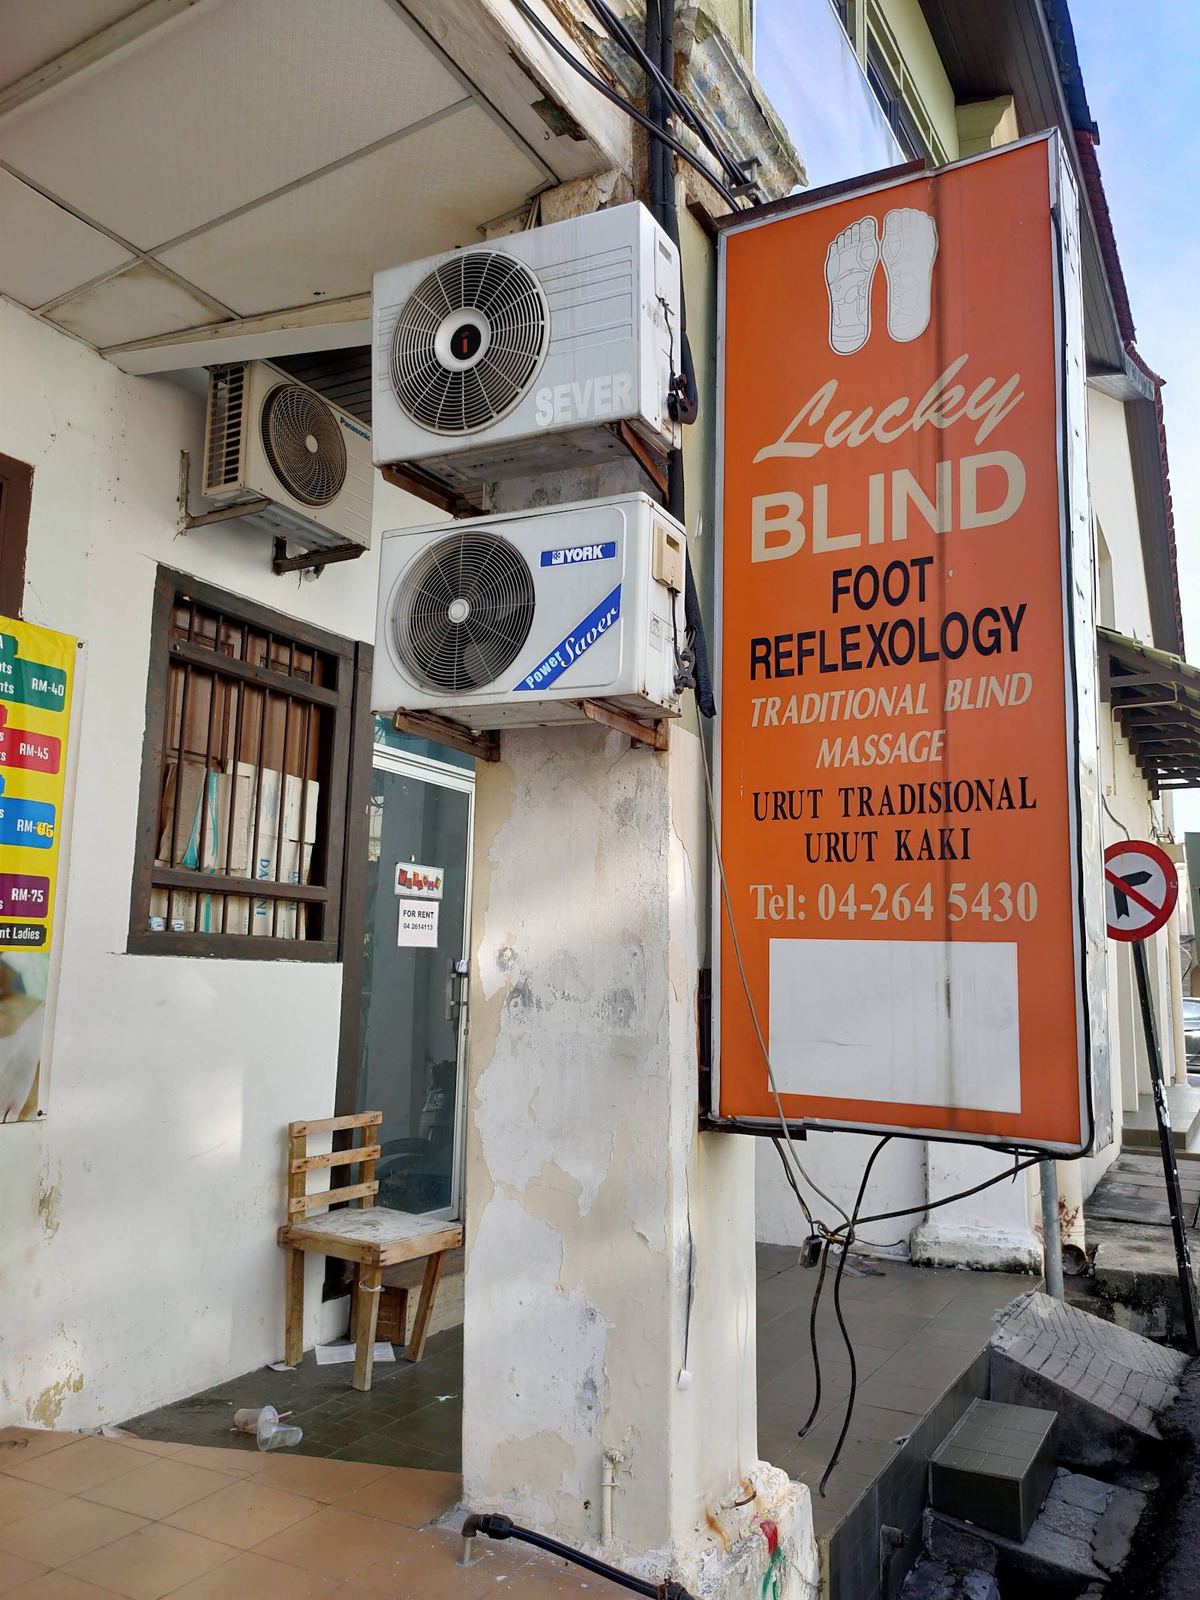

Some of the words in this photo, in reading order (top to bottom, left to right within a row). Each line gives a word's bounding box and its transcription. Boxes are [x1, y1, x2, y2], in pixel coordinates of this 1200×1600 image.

[535, 371, 633, 426] SEVER
[752, 352, 1025, 464] Lucky
[751, 450, 1027, 564] BLIND
[565, 545, 603, 563] YORK
[831, 556, 934, 614] FOOT
[525, 651, 563, 689] Power
[561, 606, 619, 668] Saver
[750, 603, 1028, 681] REFLEXOLOGY
[31, 677, 65, 697] RM-40
[751, 682, 929, 728] TRADITIONAL
[944, 671, 1033, 712] BLIND
[19, 742, 49, 760] RM-45
[815, 728, 947, 769] MASSAGE
[752, 788, 823, 821] URUT
[838, 775, 1037, 818] TRADISIONAL
[804, 830, 878, 864] URUT
[894, 827, 972, 862] KAKI
[11, 887, 44, 903] RM-75
[403, 909, 416, 918] FOR
[417, 910, 434, 919] RENT
[750, 884, 806, 920] Tel:
[817, 881, 934, 921] 04-264
[947, 881, 1038, 922] 5430
[13, 926, 41, 940] Ladies
